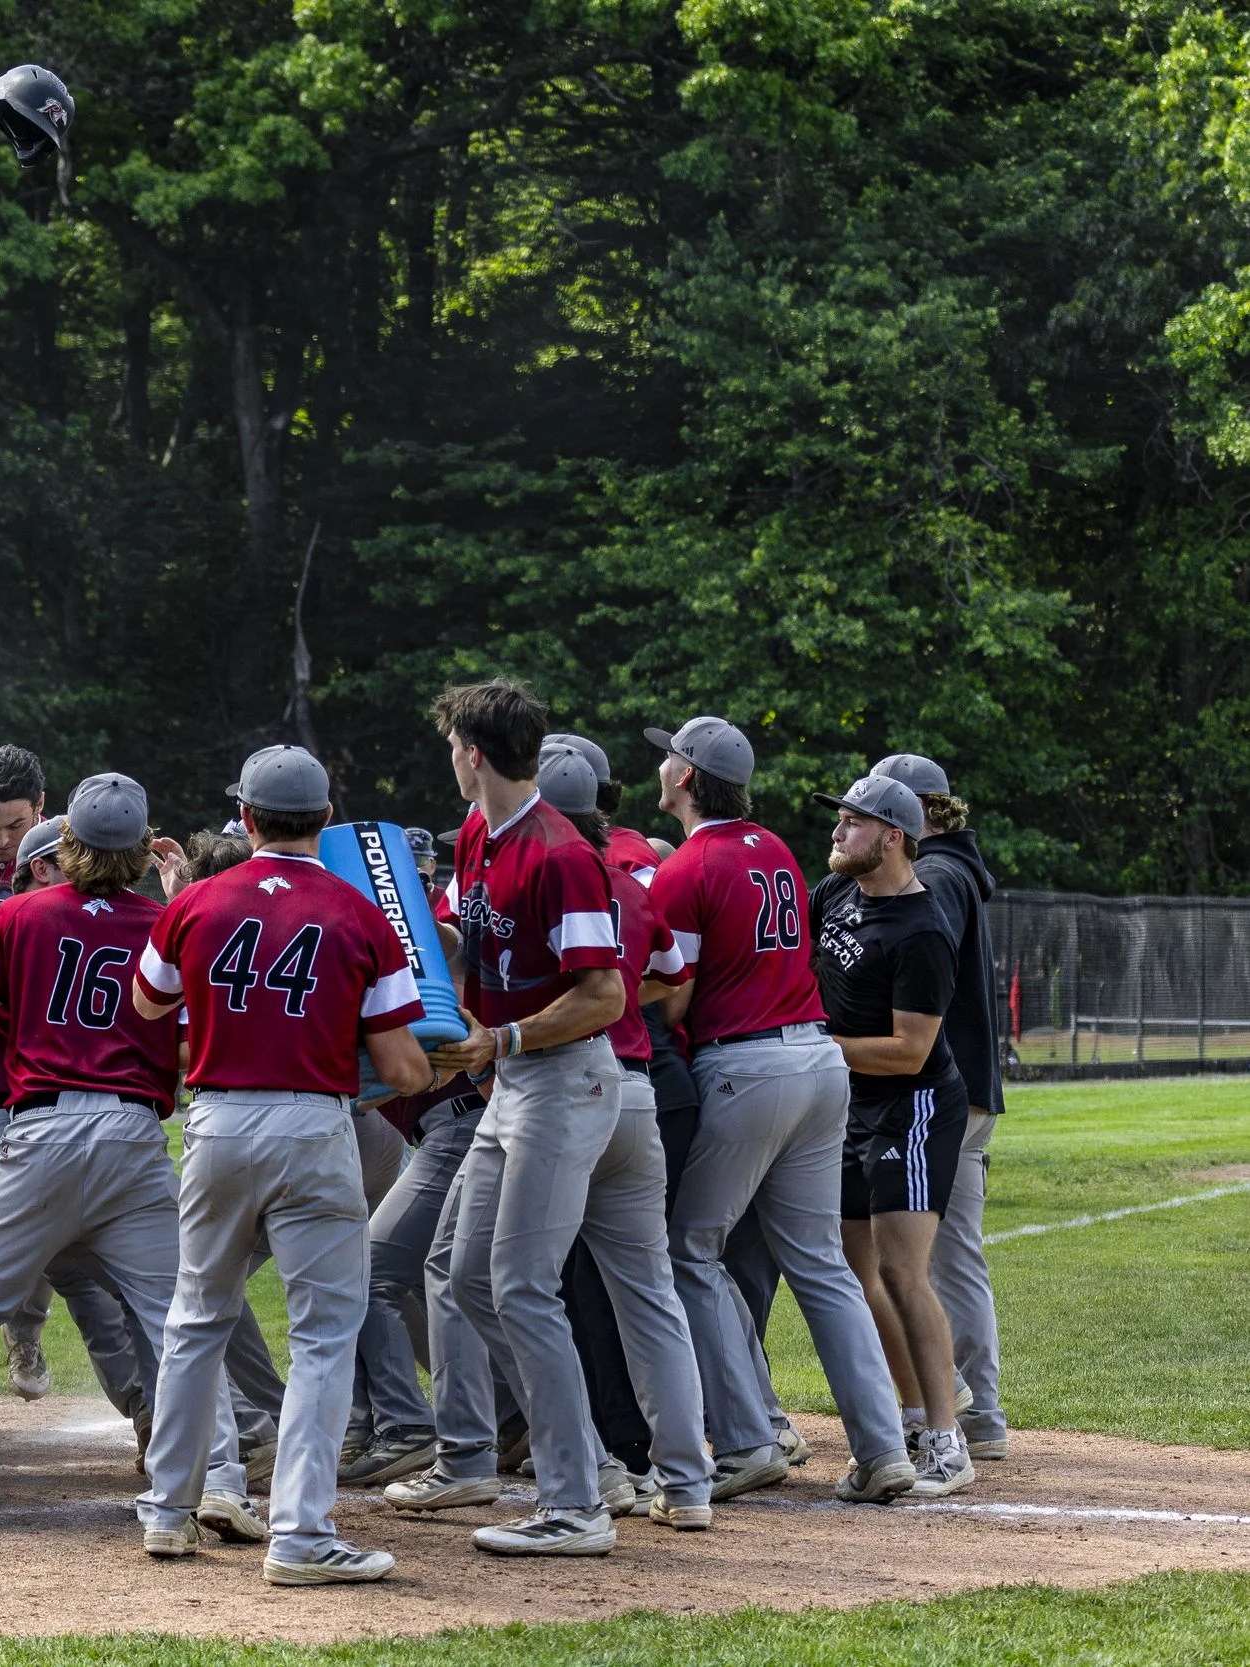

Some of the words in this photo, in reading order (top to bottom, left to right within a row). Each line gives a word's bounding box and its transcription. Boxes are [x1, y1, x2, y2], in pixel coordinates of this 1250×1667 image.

[748, 869, 801, 952] 28
[46, 936, 132, 1030] 16
[209, 918, 323, 1017] 44
